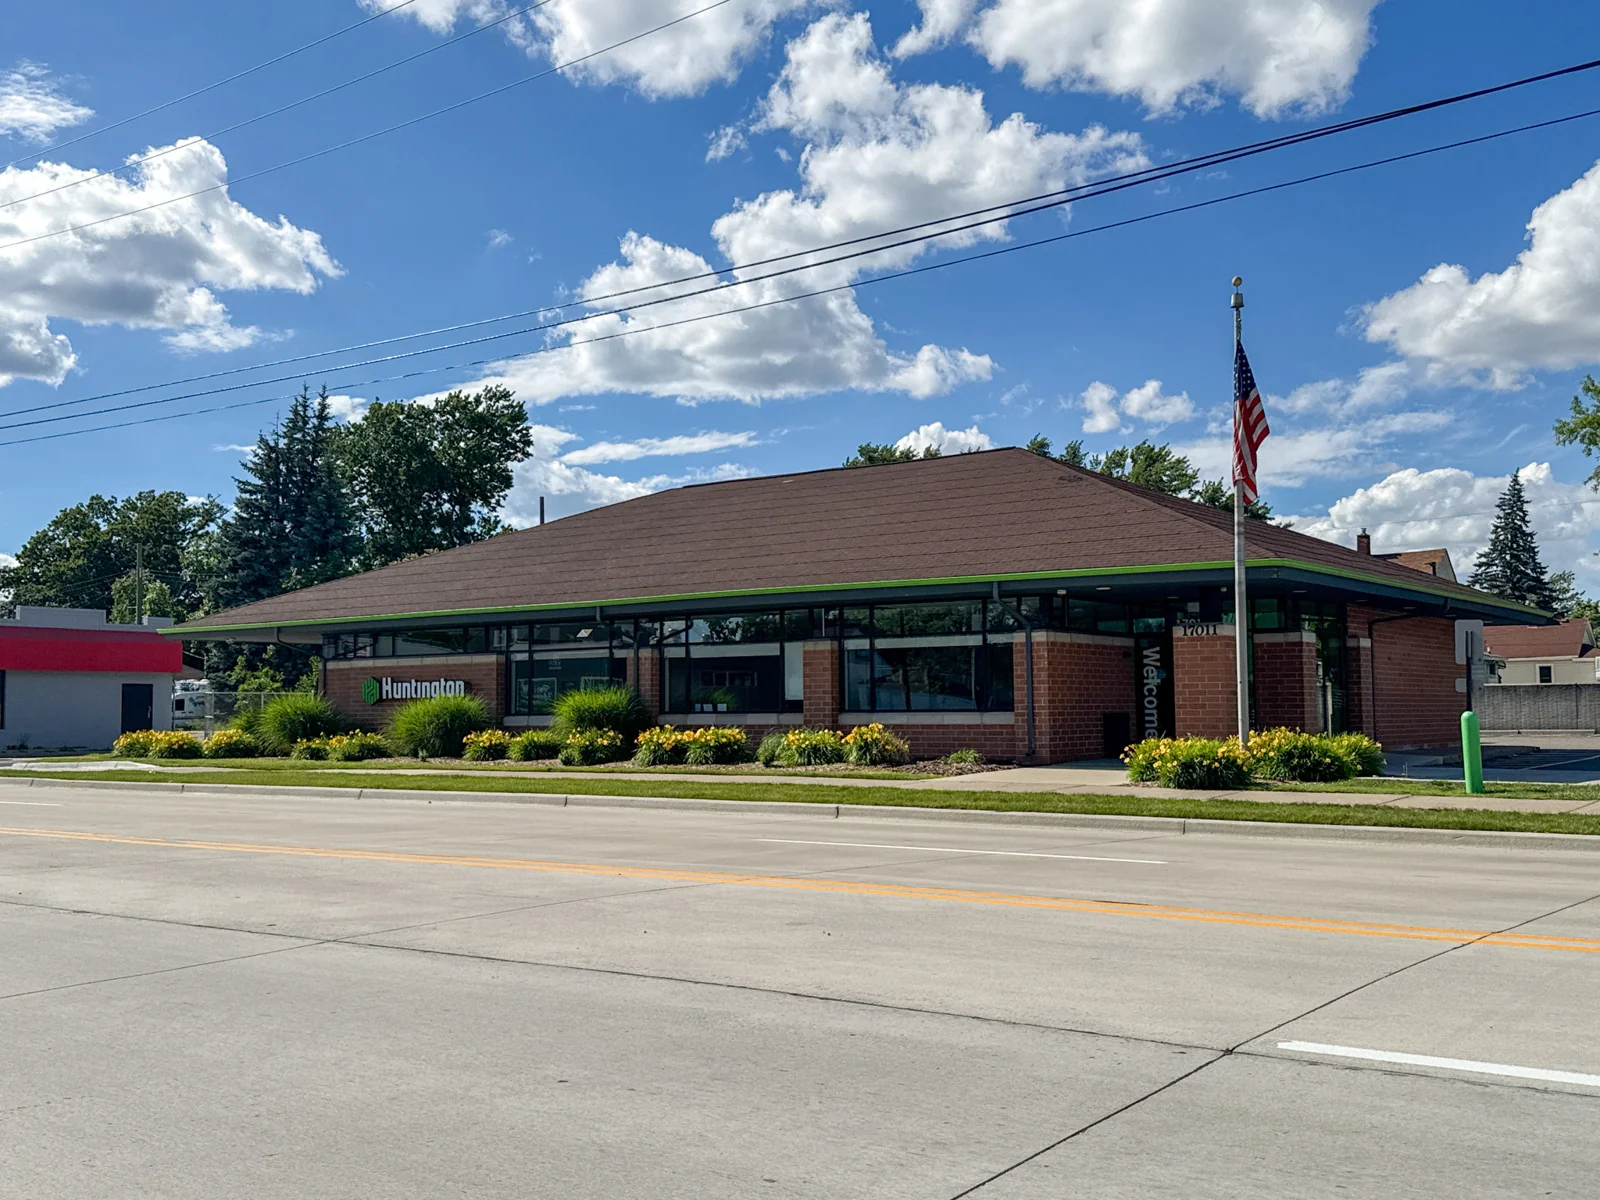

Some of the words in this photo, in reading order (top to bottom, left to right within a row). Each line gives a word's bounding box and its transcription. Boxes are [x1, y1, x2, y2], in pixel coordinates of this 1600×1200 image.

[1182, 624, 1218, 637] 17011
[382, 677, 465, 699] Huntington
[1142, 646, 1162, 739] Welcome
